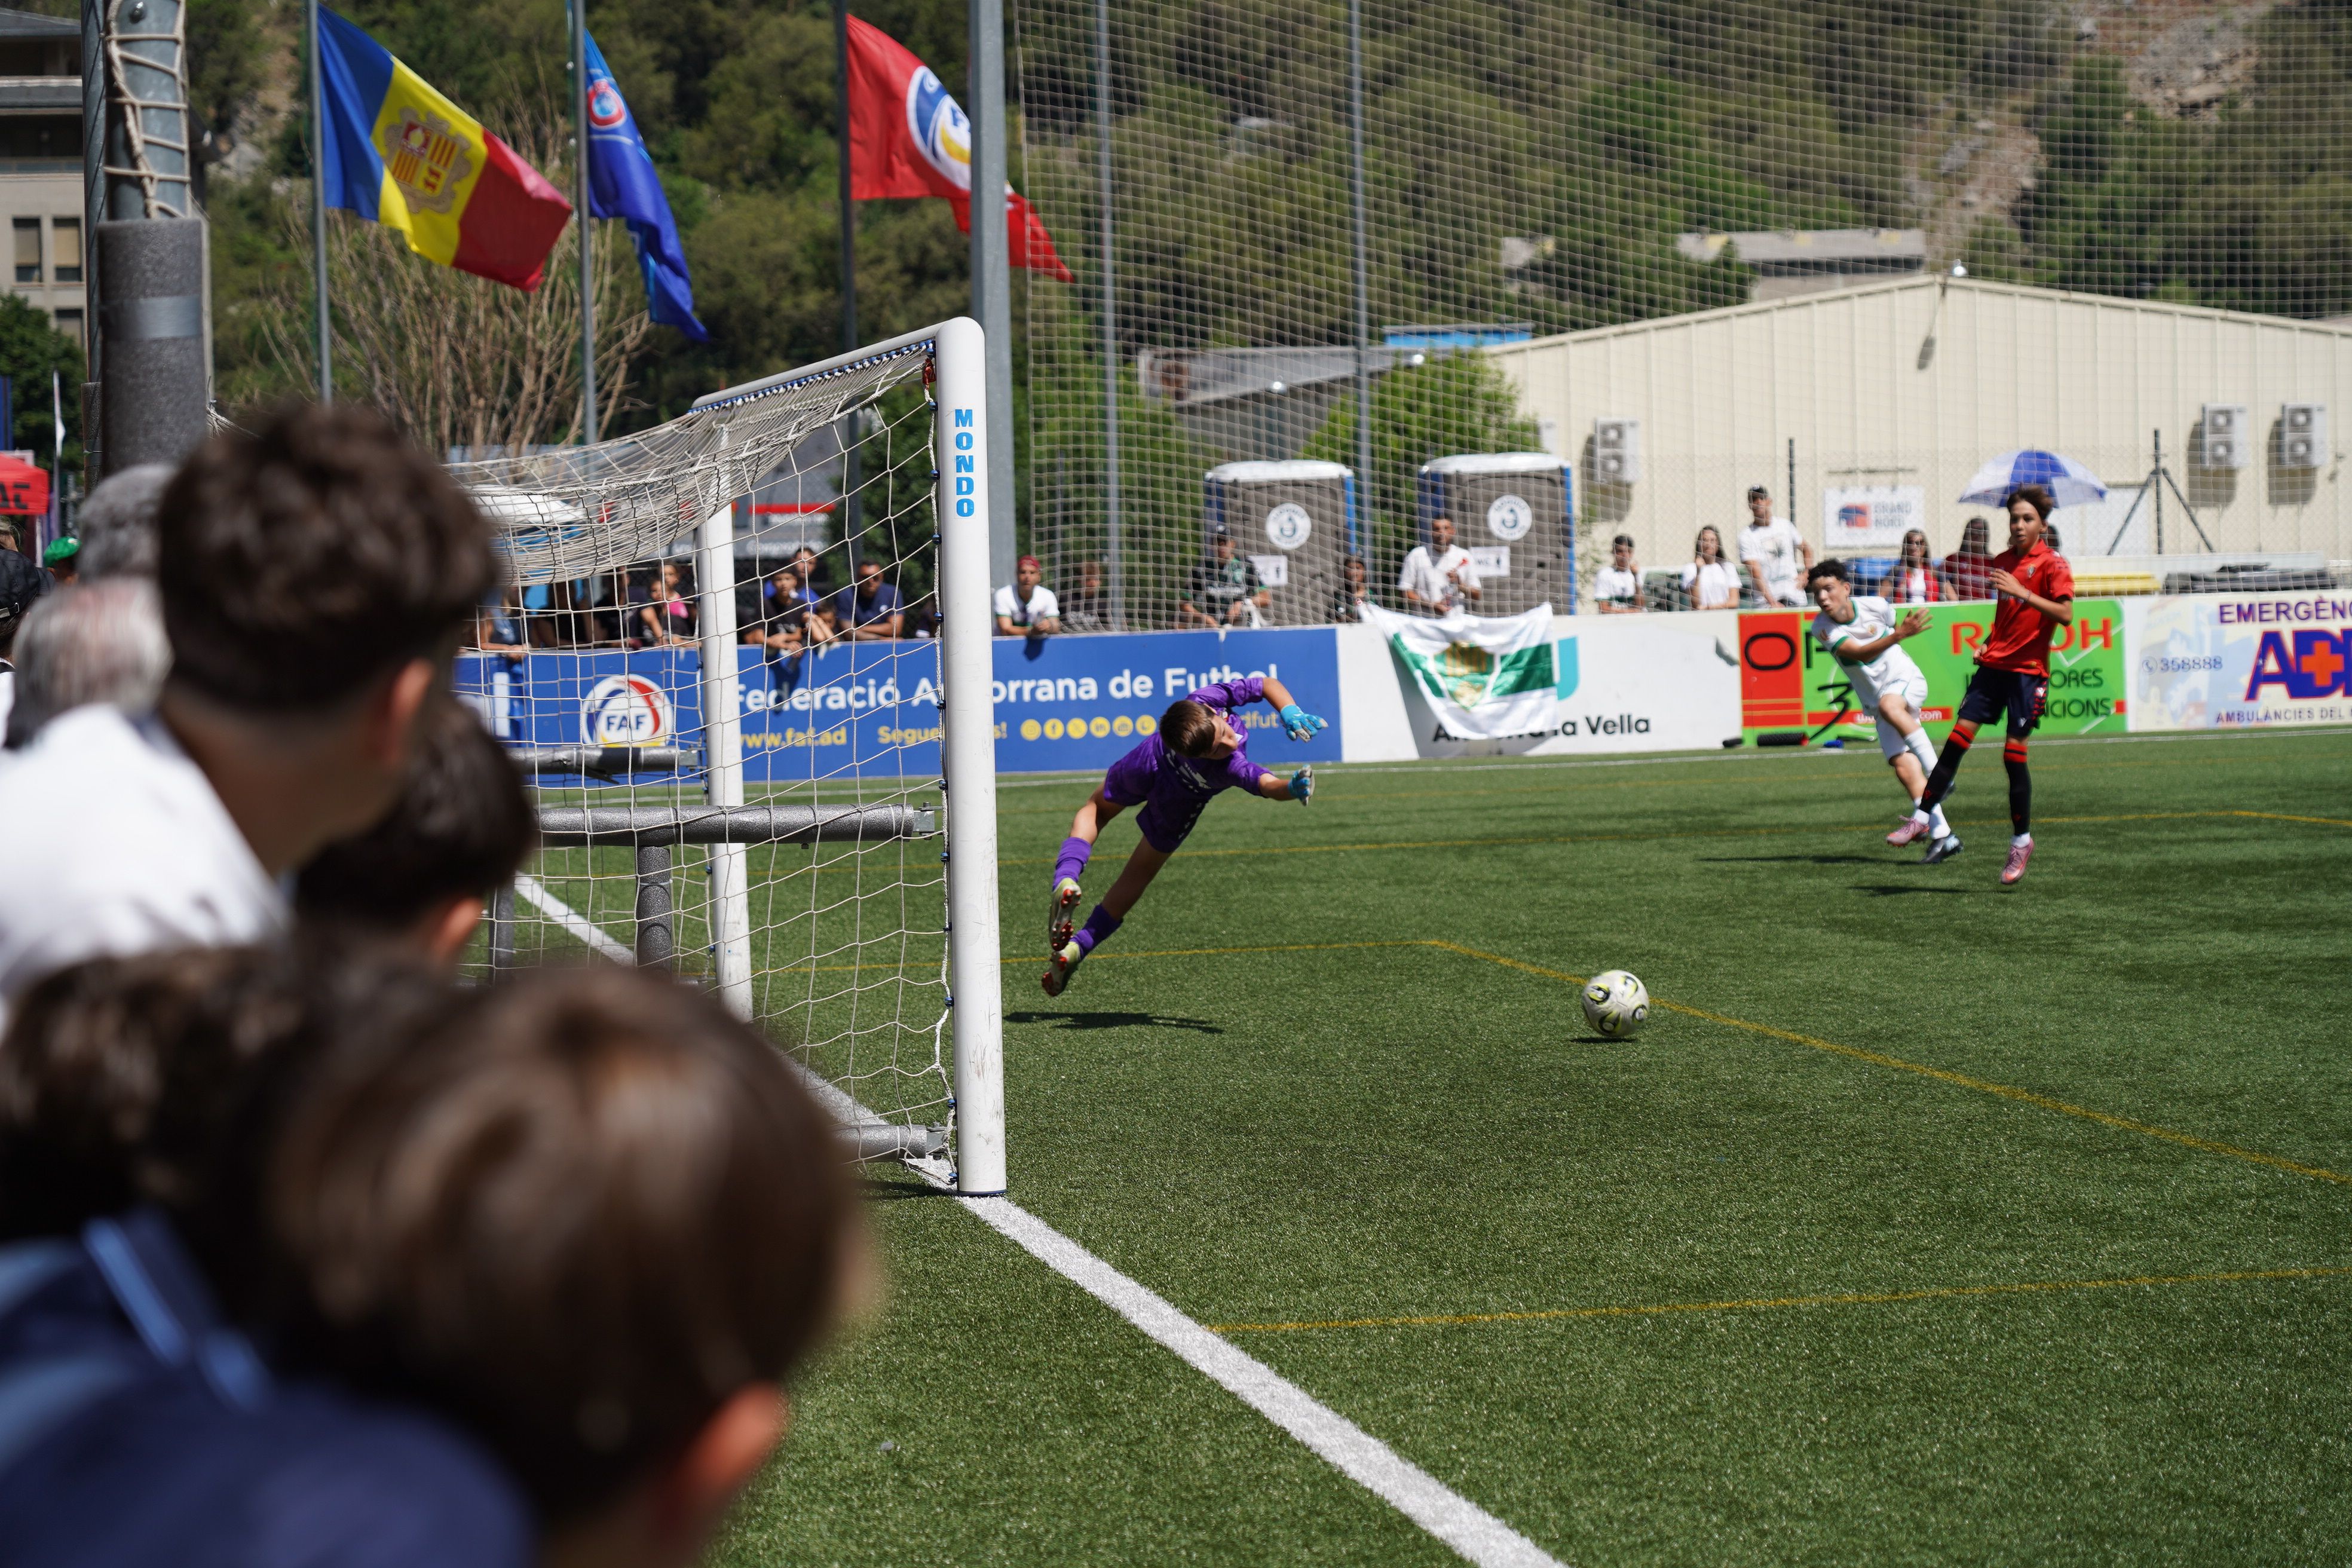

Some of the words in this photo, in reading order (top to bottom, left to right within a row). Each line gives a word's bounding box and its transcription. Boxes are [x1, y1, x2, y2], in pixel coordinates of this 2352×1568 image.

[955, 409, 975, 517] MONDO
[2219, 596, 2352, 623] EMERGÈN
[911, 675, 1098, 706] Aorrana
[1108, 669, 1153, 699] de
[607, 715, 647, 731] FAF
[1585, 713, 1650, 736] Vella
